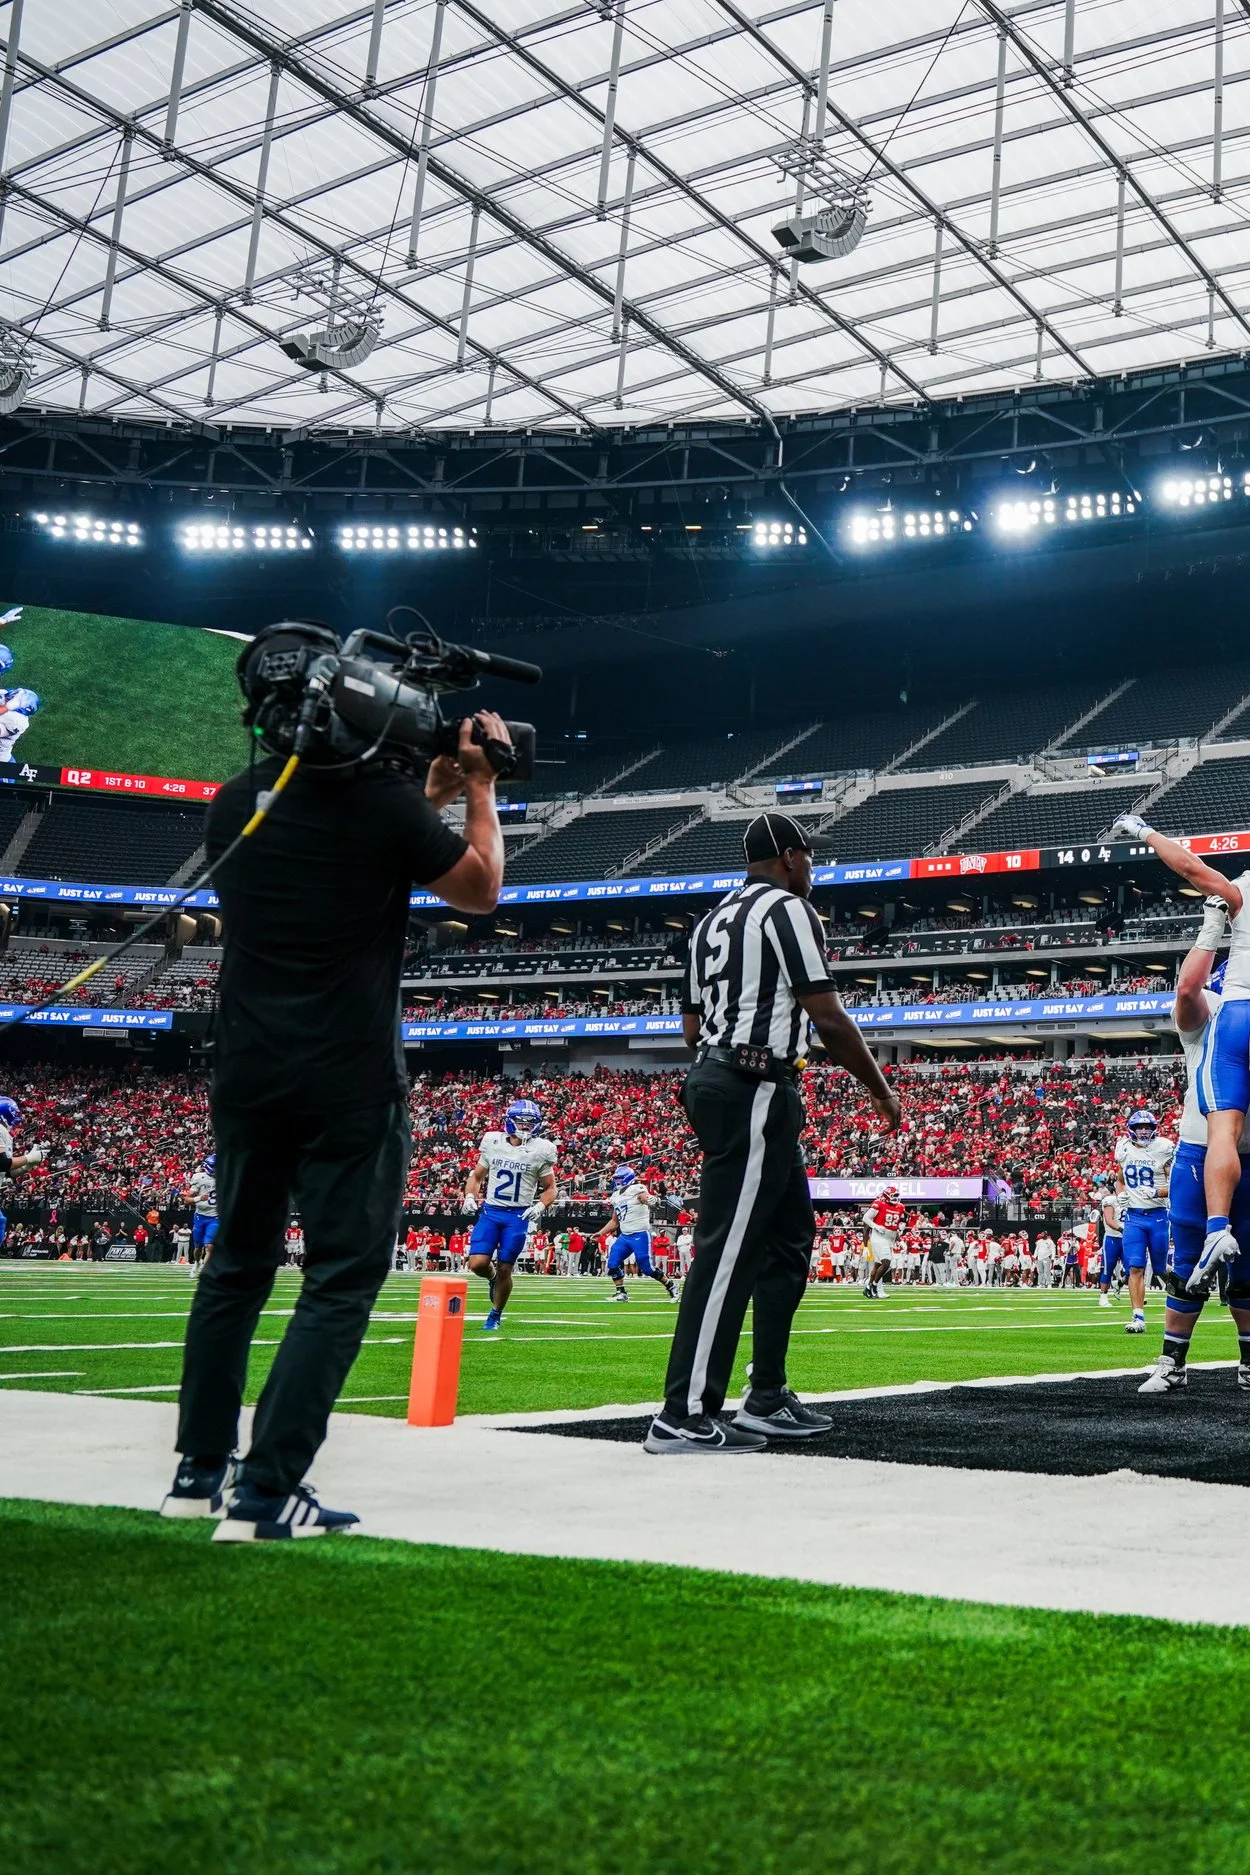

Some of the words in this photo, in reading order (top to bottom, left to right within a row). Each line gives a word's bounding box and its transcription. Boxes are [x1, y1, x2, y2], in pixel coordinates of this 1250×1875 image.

[67, 770, 92, 786] Q2
[105, 776, 122, 787] 1ST
[125, 778, 132, 787] &
[134, 779, 146, 789] 10
[163, 783, 186, 793] 4:26
[203, 787, 216, 796] 37
[1209, 837, 1239, 851] 4:26
[1006, 854, 1021, 869] 10
[1057, 850, 1074, 865] 14
[1081, 849, 1090, 862] 0
[844, 870, 864, 880] JUST
[865, 868, 883, 878] SAY
[4, 884, 24, 893] SAY
[650, 883, 668, 892] JUST
[669, 882, 686, 891] SAY
[713, 879, 732, 889] JUST
[58, 888, 81, 897] JUST
[83, 890, 103, 899] SAY
[526, 890, 544, 899] JUST
[545, 889, 561, 899] SAY
[587, 887, 605, 896] JUST
[607, 886, 623, 895] SAY
[134, 893, 156, 901] JUST
[158, 894, 177, 903] SAY
[1043, 1005, 1064, 1015] JUST
[1065, 1004, 1084, 1014] SAY
[1116, 1002, 1138, 1011] JUST
[1139, 1000, 1158, 1010] SAY
[50, 1012, 70, 1022] SAY
[857, 1012, 875, 1022] SAY
[904, 1010, 924, 1020] JUST
[924, 1010, 942, 1019] SAY
[972, 1008, 992, 1018] JUST
[994, 1007, 1012, 1017] SAY
[101, 1014, 124, 1024] JUST
[126, 1015, 146, 1025] SAY
[467, 1026, 484, 1035] JUST
[485, 1025, 500, 1035] SAY
[525, 1025, 542, 1034] JUST
[543, 1024, 559, 1033] SAY
[585, 1023, 602, 1032] JUST
[603, 1022, 620, 1031] SAY
[646, 1021, 664, 1031] JUST
[665, 1020, 681, 1030] SAY
[409, 1027, 425, 1036] JUST
[426, 1027, 442, 1036] SAY
[492, 1157, 505, 1169] AIR
[506, 1160, 532, 1173] FORCE
[1125, 1165, 1155, 1189] 88
[493, 1169, 522, 1203] 21
[850, 1181, 886, 1197] TACO
